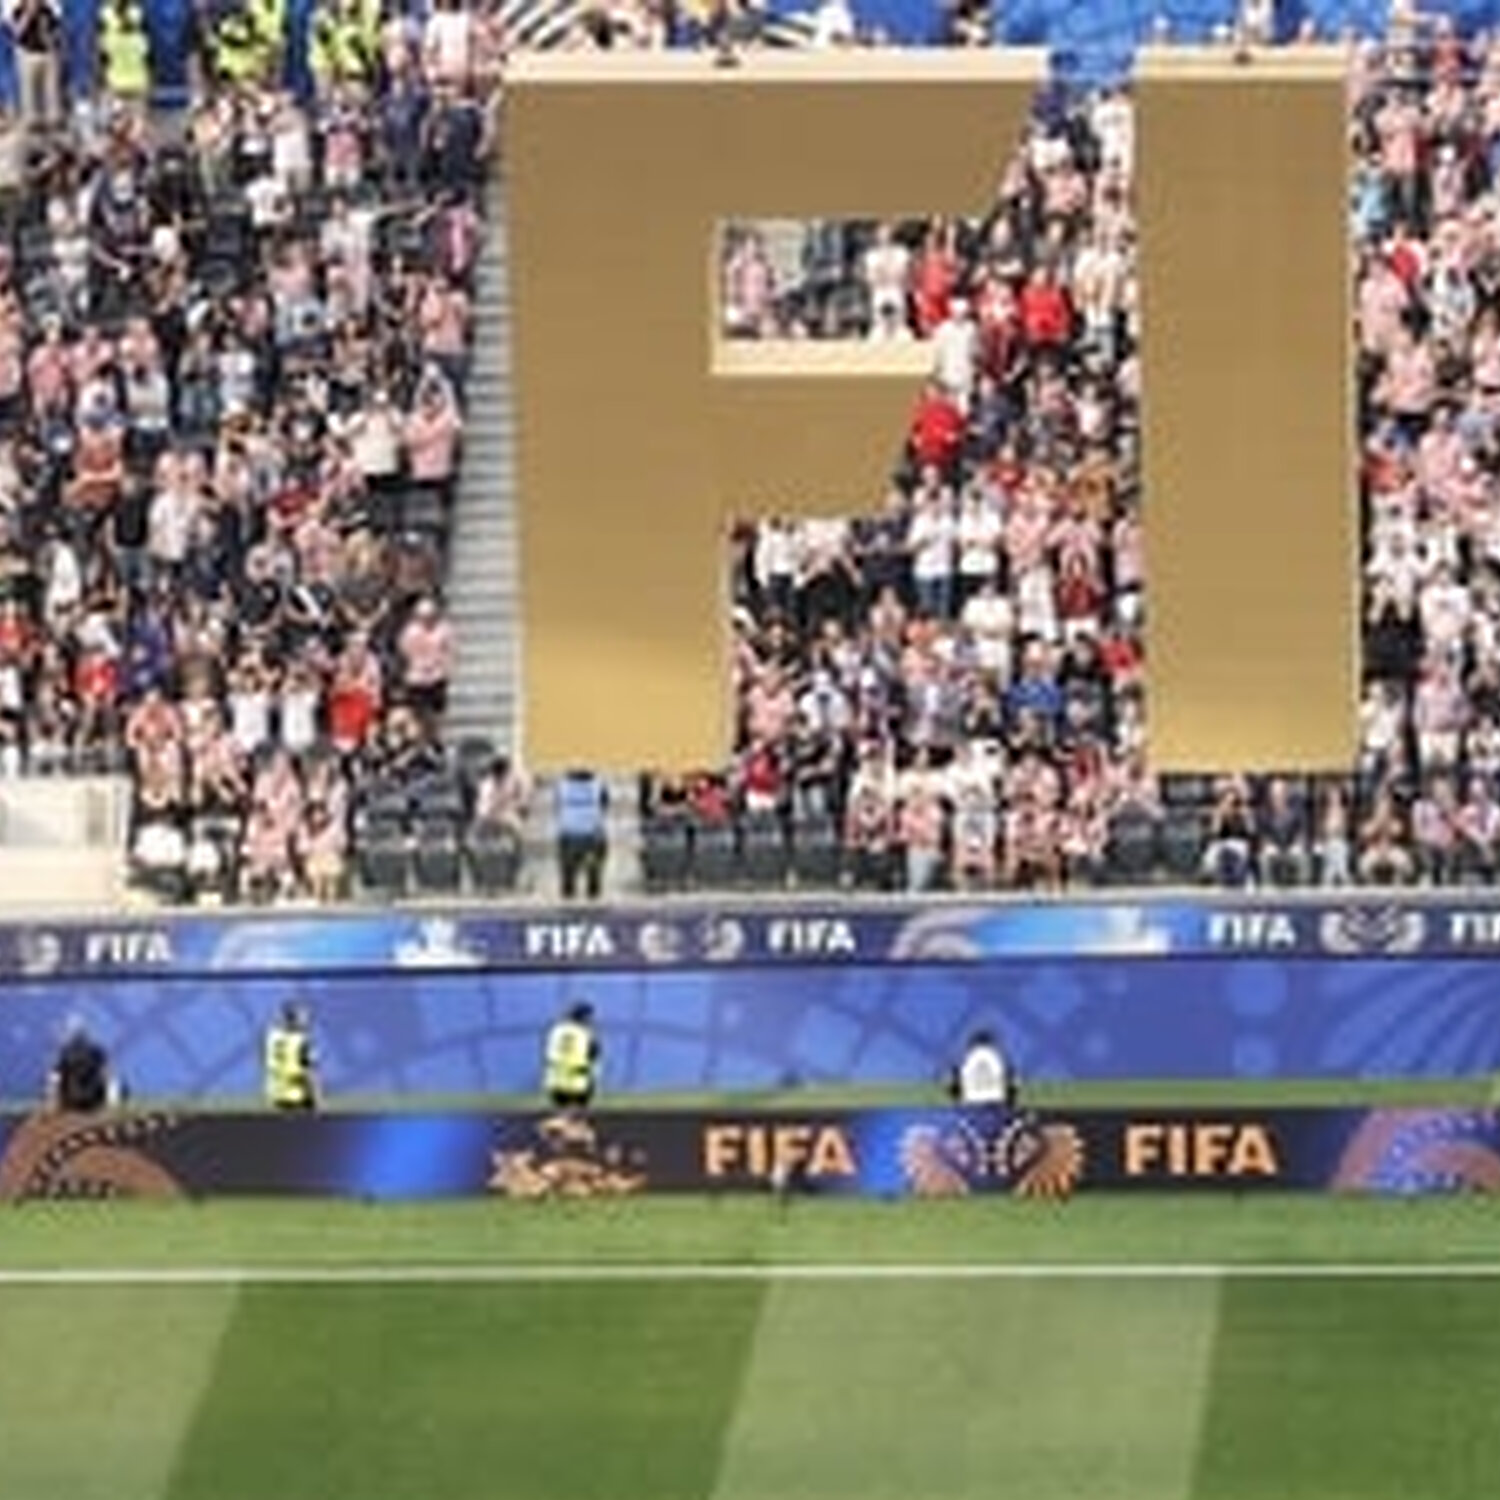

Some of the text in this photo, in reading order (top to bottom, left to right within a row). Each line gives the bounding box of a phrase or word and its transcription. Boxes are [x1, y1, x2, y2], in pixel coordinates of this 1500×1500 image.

[526, 926, 612, 955] FIFA
[769, 922, 854, 949] FIFA
[1209, 914, 1294, 942] FIFA
[87, 933, 172, 962] FIFA
[706, 1126, 852, 1175] FIFA
[1126, 1126, 1276, 1175] FIFA
